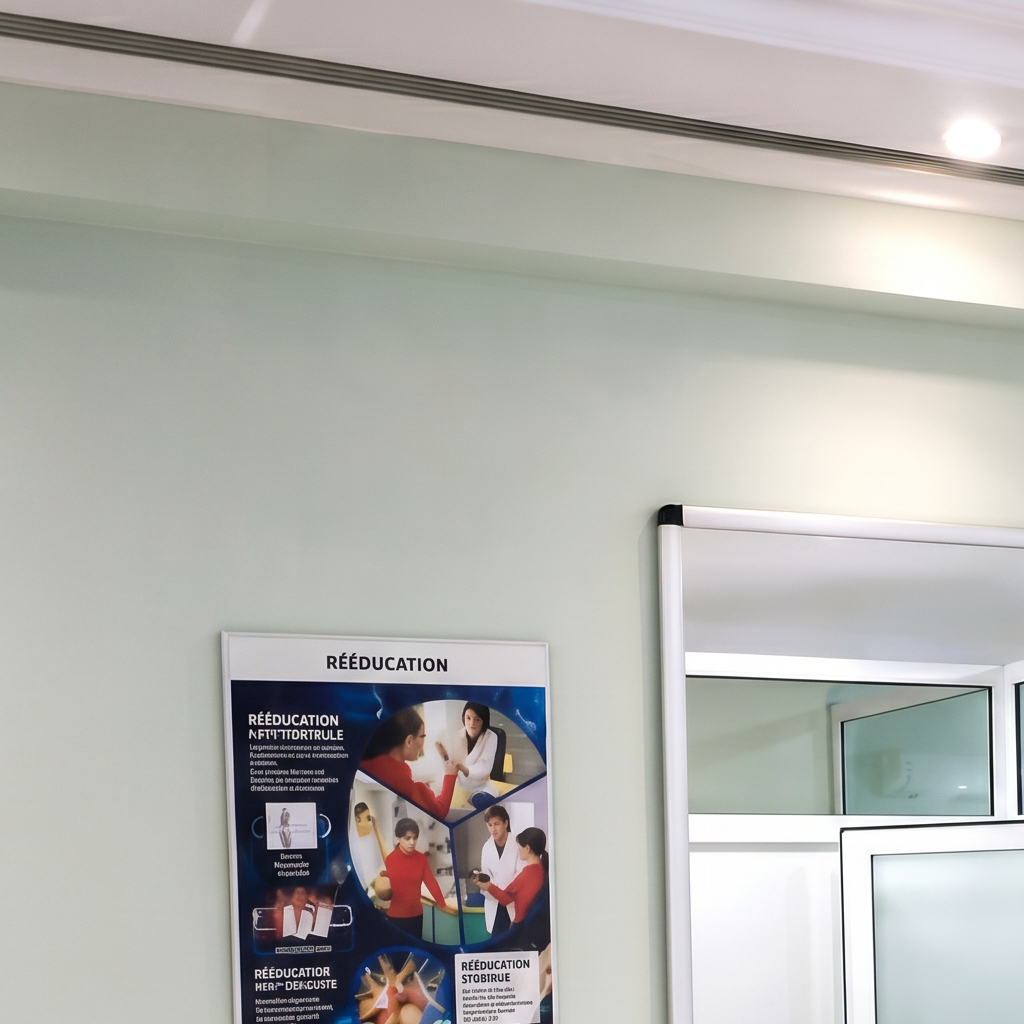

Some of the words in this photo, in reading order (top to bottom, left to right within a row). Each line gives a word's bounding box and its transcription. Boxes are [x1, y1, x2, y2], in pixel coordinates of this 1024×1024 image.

[326, 652, 448, 672] RÉÉDUCATION
[248, 711, 339, 726] RÉÉDUCATION
[461, 959, 530, 971] RÉÉDUCATION
